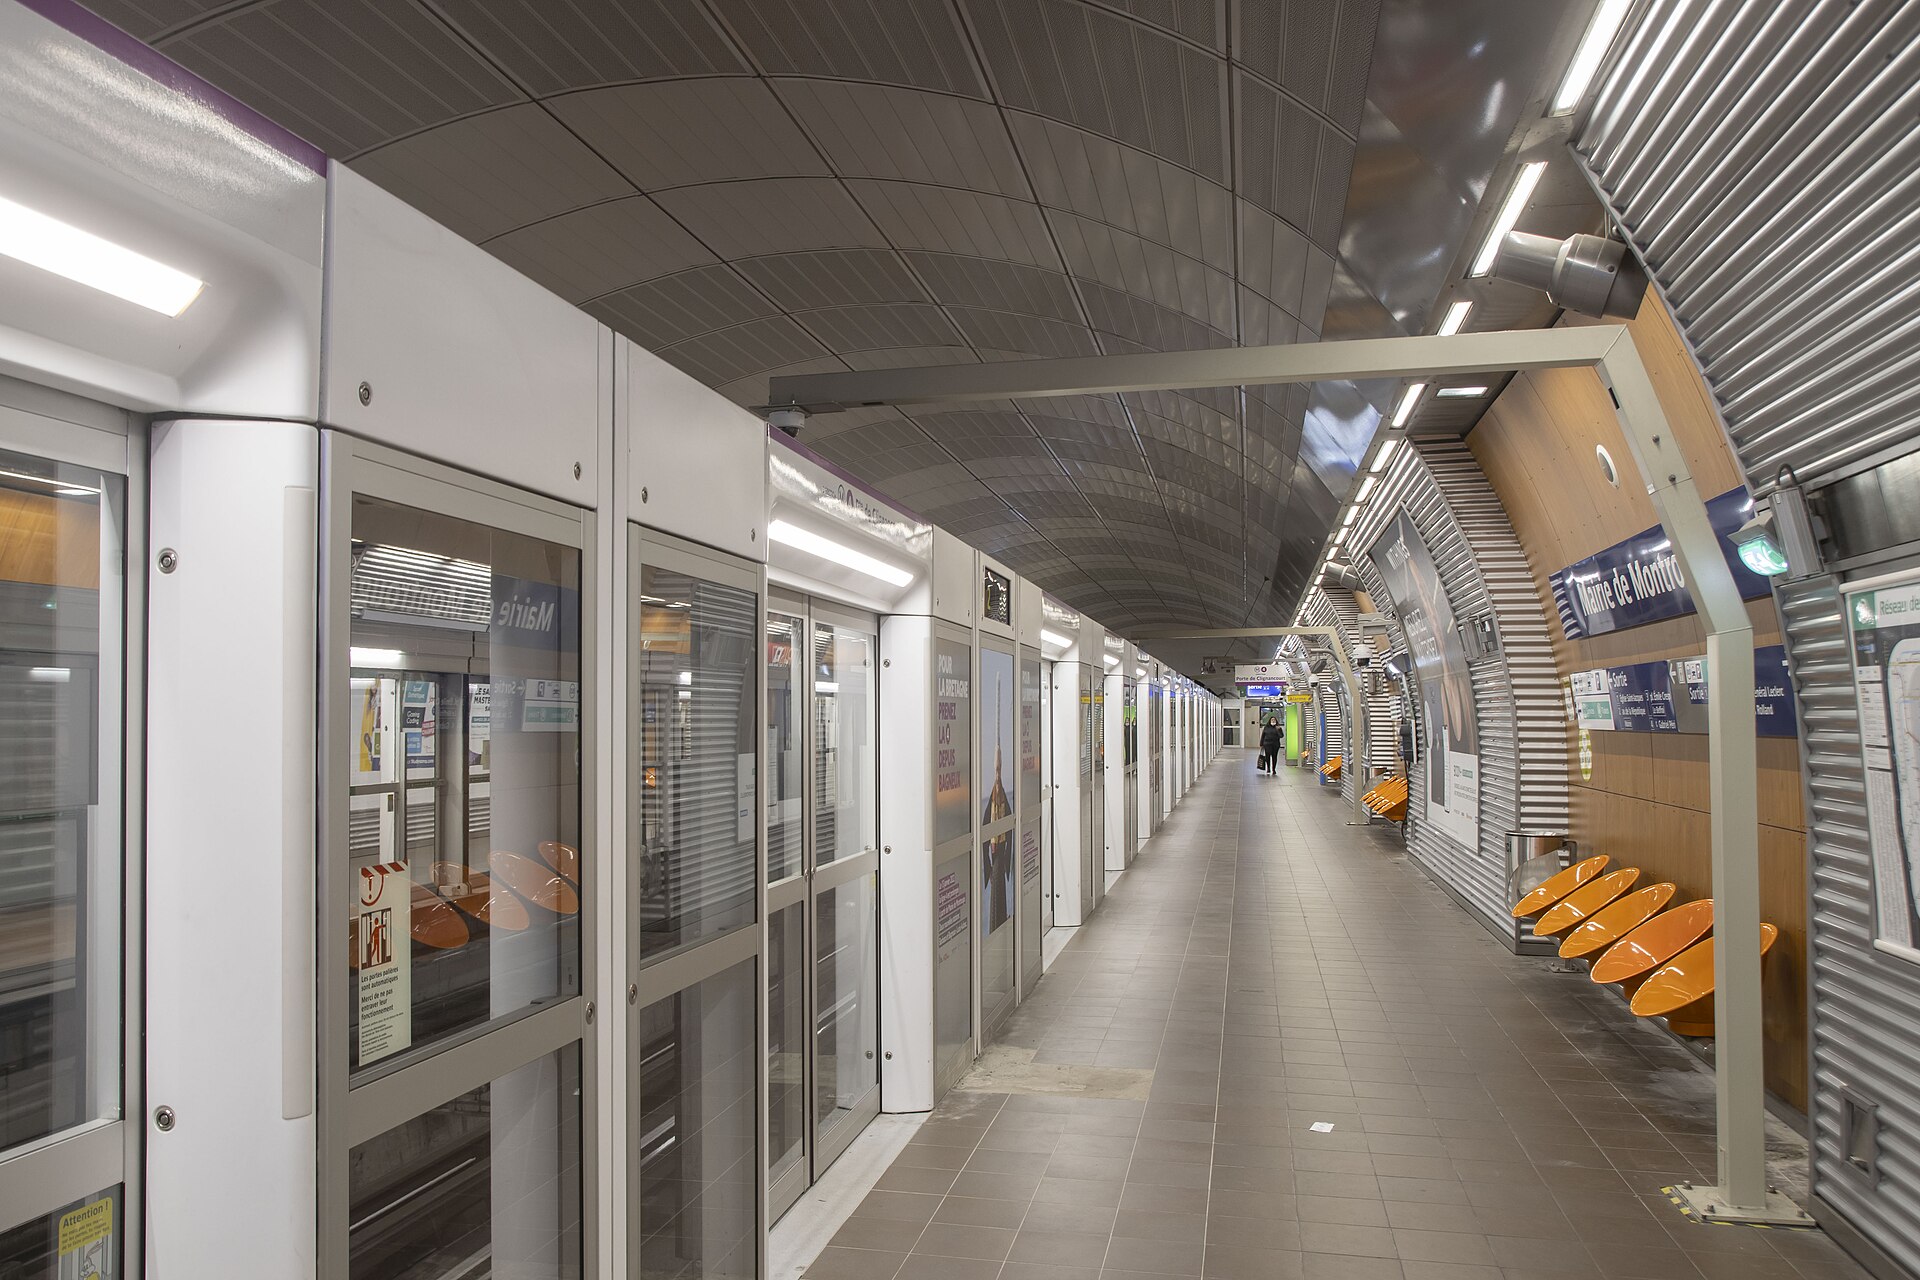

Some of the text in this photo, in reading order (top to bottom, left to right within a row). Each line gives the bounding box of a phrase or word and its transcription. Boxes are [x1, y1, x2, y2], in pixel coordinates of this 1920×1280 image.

[1577, 553, 1686, 617] Mairie de Montro
[1879, 599, 1906, 616] Réseau
[938, 654, 953, 674] POUR
[938, 677, 969, 699] LA BRETAGNE
[1612, 671, 1628, 688] Sortie
[473, 696, 491, 704] MASTE
[1689, 686, 1705, 701] Sortie
[1754, 685, 1785, 698] énéral Leclerc
[938, 702, 957, 720] PRENEZ
[1756, 703, 1774, 715] Rolland
[938, 725, 946, 744] LA
[938, 748, 956, 768] DEPUIS
[938, 770, 961, 792] BAGNEUX
[361, 966, 399, 983] Les portes palières
[361, 975, 399, 992] sont automatiques
[361, 994, 374, 1004] Merci
[373, 991, 380, 1000] de
[385, 988, 393, 998] pas
[361, 998, 388, 1012] entraver leur
[361, 1004, 394, 1021] fonctionnement
[63, 1200, 109, 1229] Attention !
